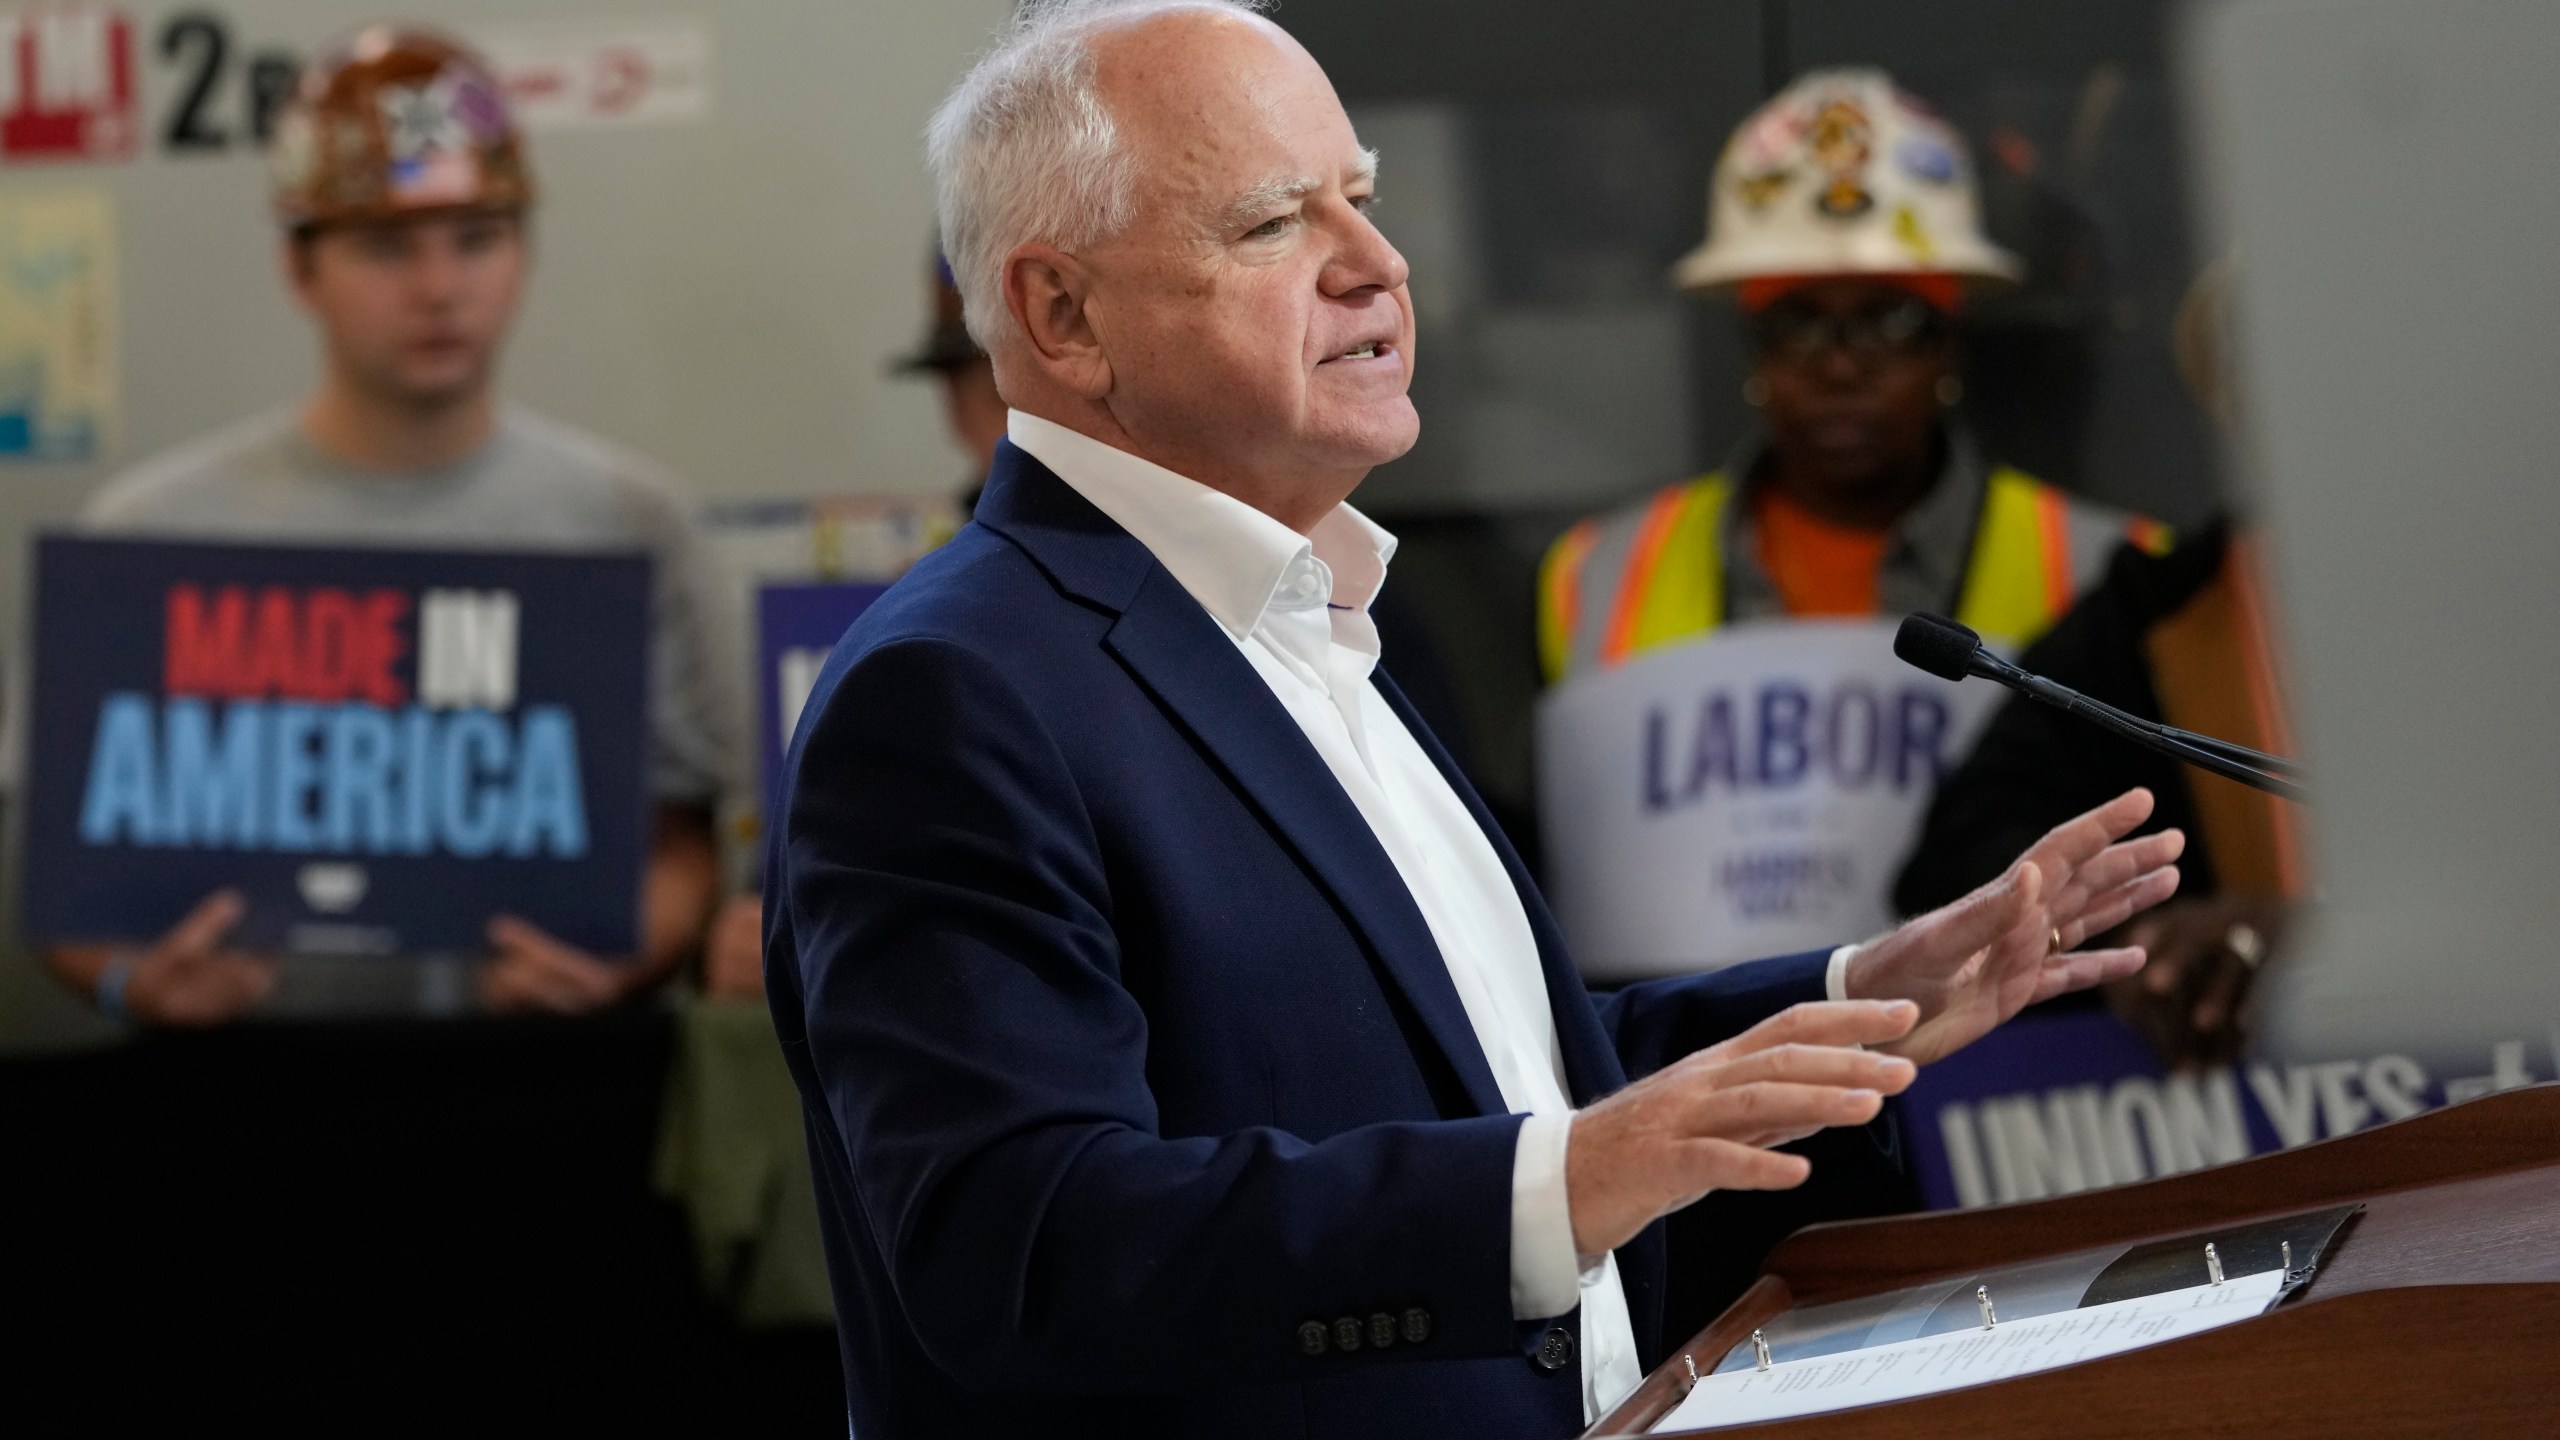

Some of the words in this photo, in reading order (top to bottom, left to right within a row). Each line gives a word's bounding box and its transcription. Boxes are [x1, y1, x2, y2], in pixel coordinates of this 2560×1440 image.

[166, 585, 409, 706] MADE
[418, 588, 520, 712] IN
[80, 692, 590, 858] AMERICA
[1642, 675, 1950, 812] LABOR
[1940, 1066, 2250, 1207] UNION
[2252, 1054, 2426, 1148] YES
